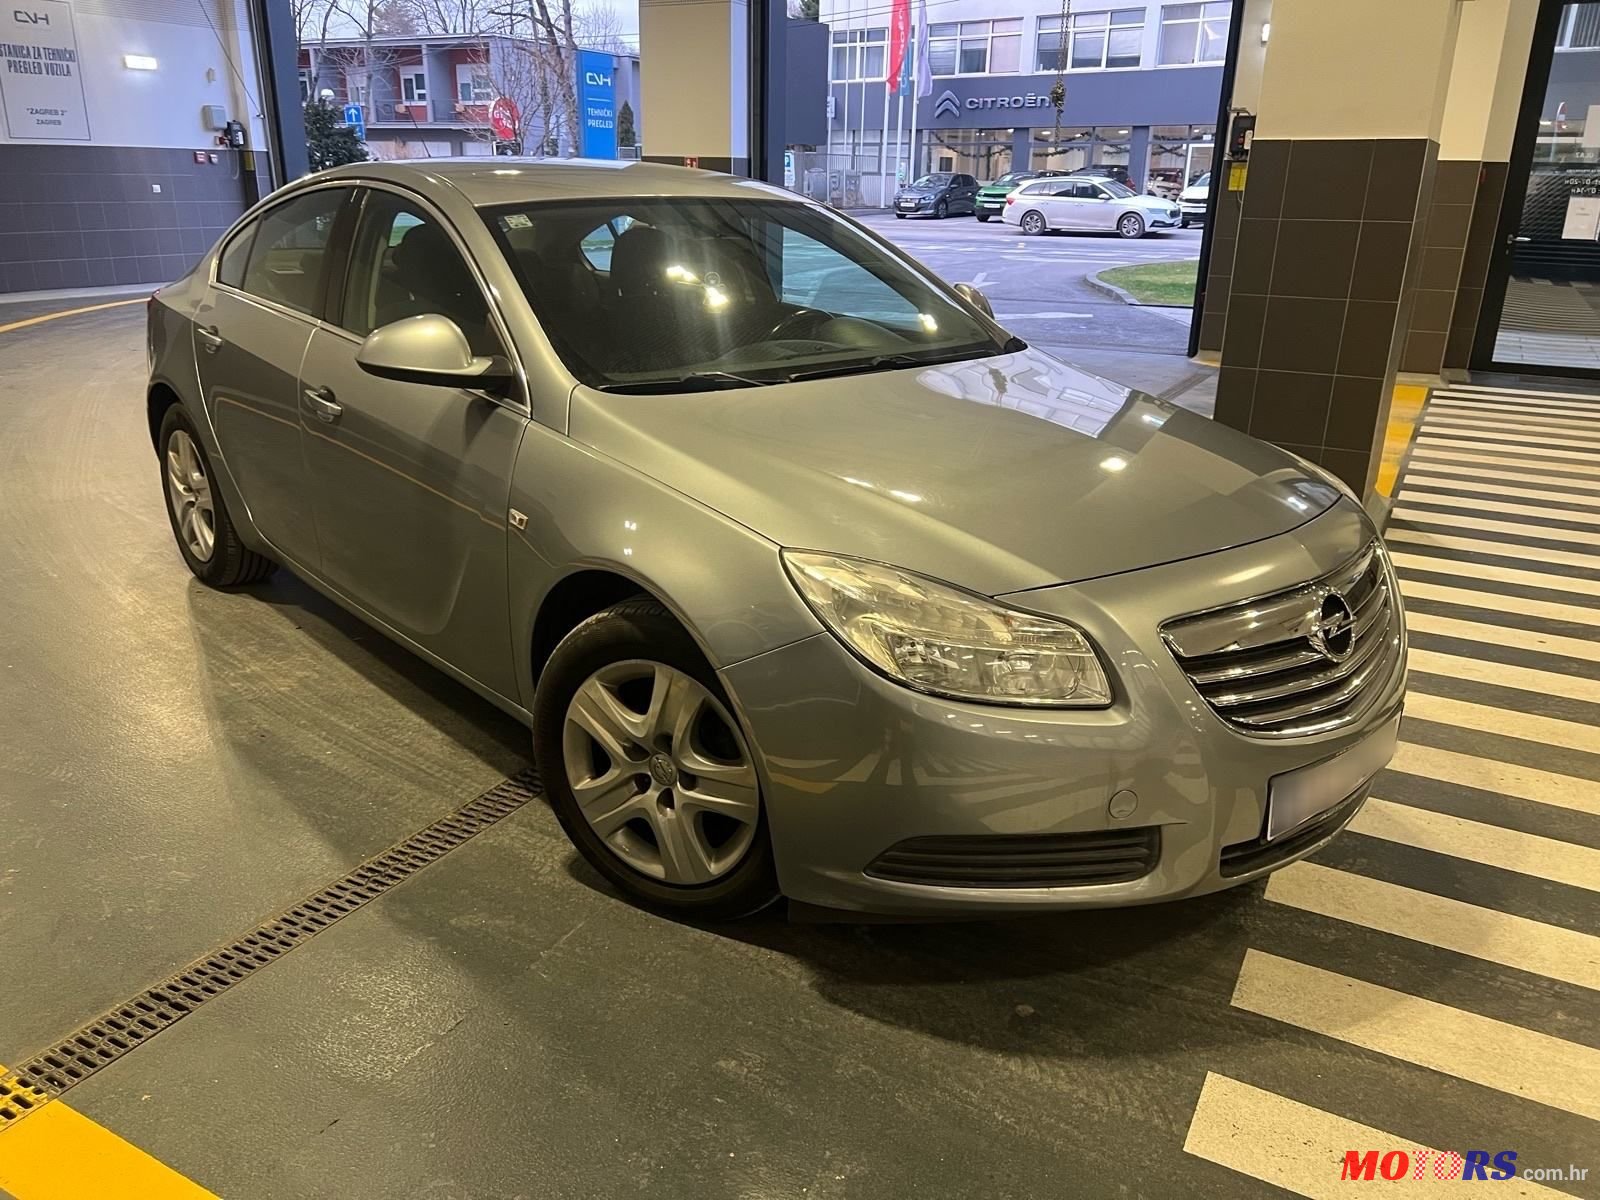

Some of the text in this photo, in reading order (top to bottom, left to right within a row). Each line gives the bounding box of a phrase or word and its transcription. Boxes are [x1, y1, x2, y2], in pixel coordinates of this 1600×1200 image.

[13, 10, 50, 25] CVH
[32, 46, 42, 59] ZA
[43, 47, 76, 62] TEHNIČKI
[8, 59, 72, 76] PREGLED VOZILA
[586, 72, 611, 86] CVH
[587, 107, 613, 118] TEHNIČKI
[587, 119, 613, 129] PREGLED
